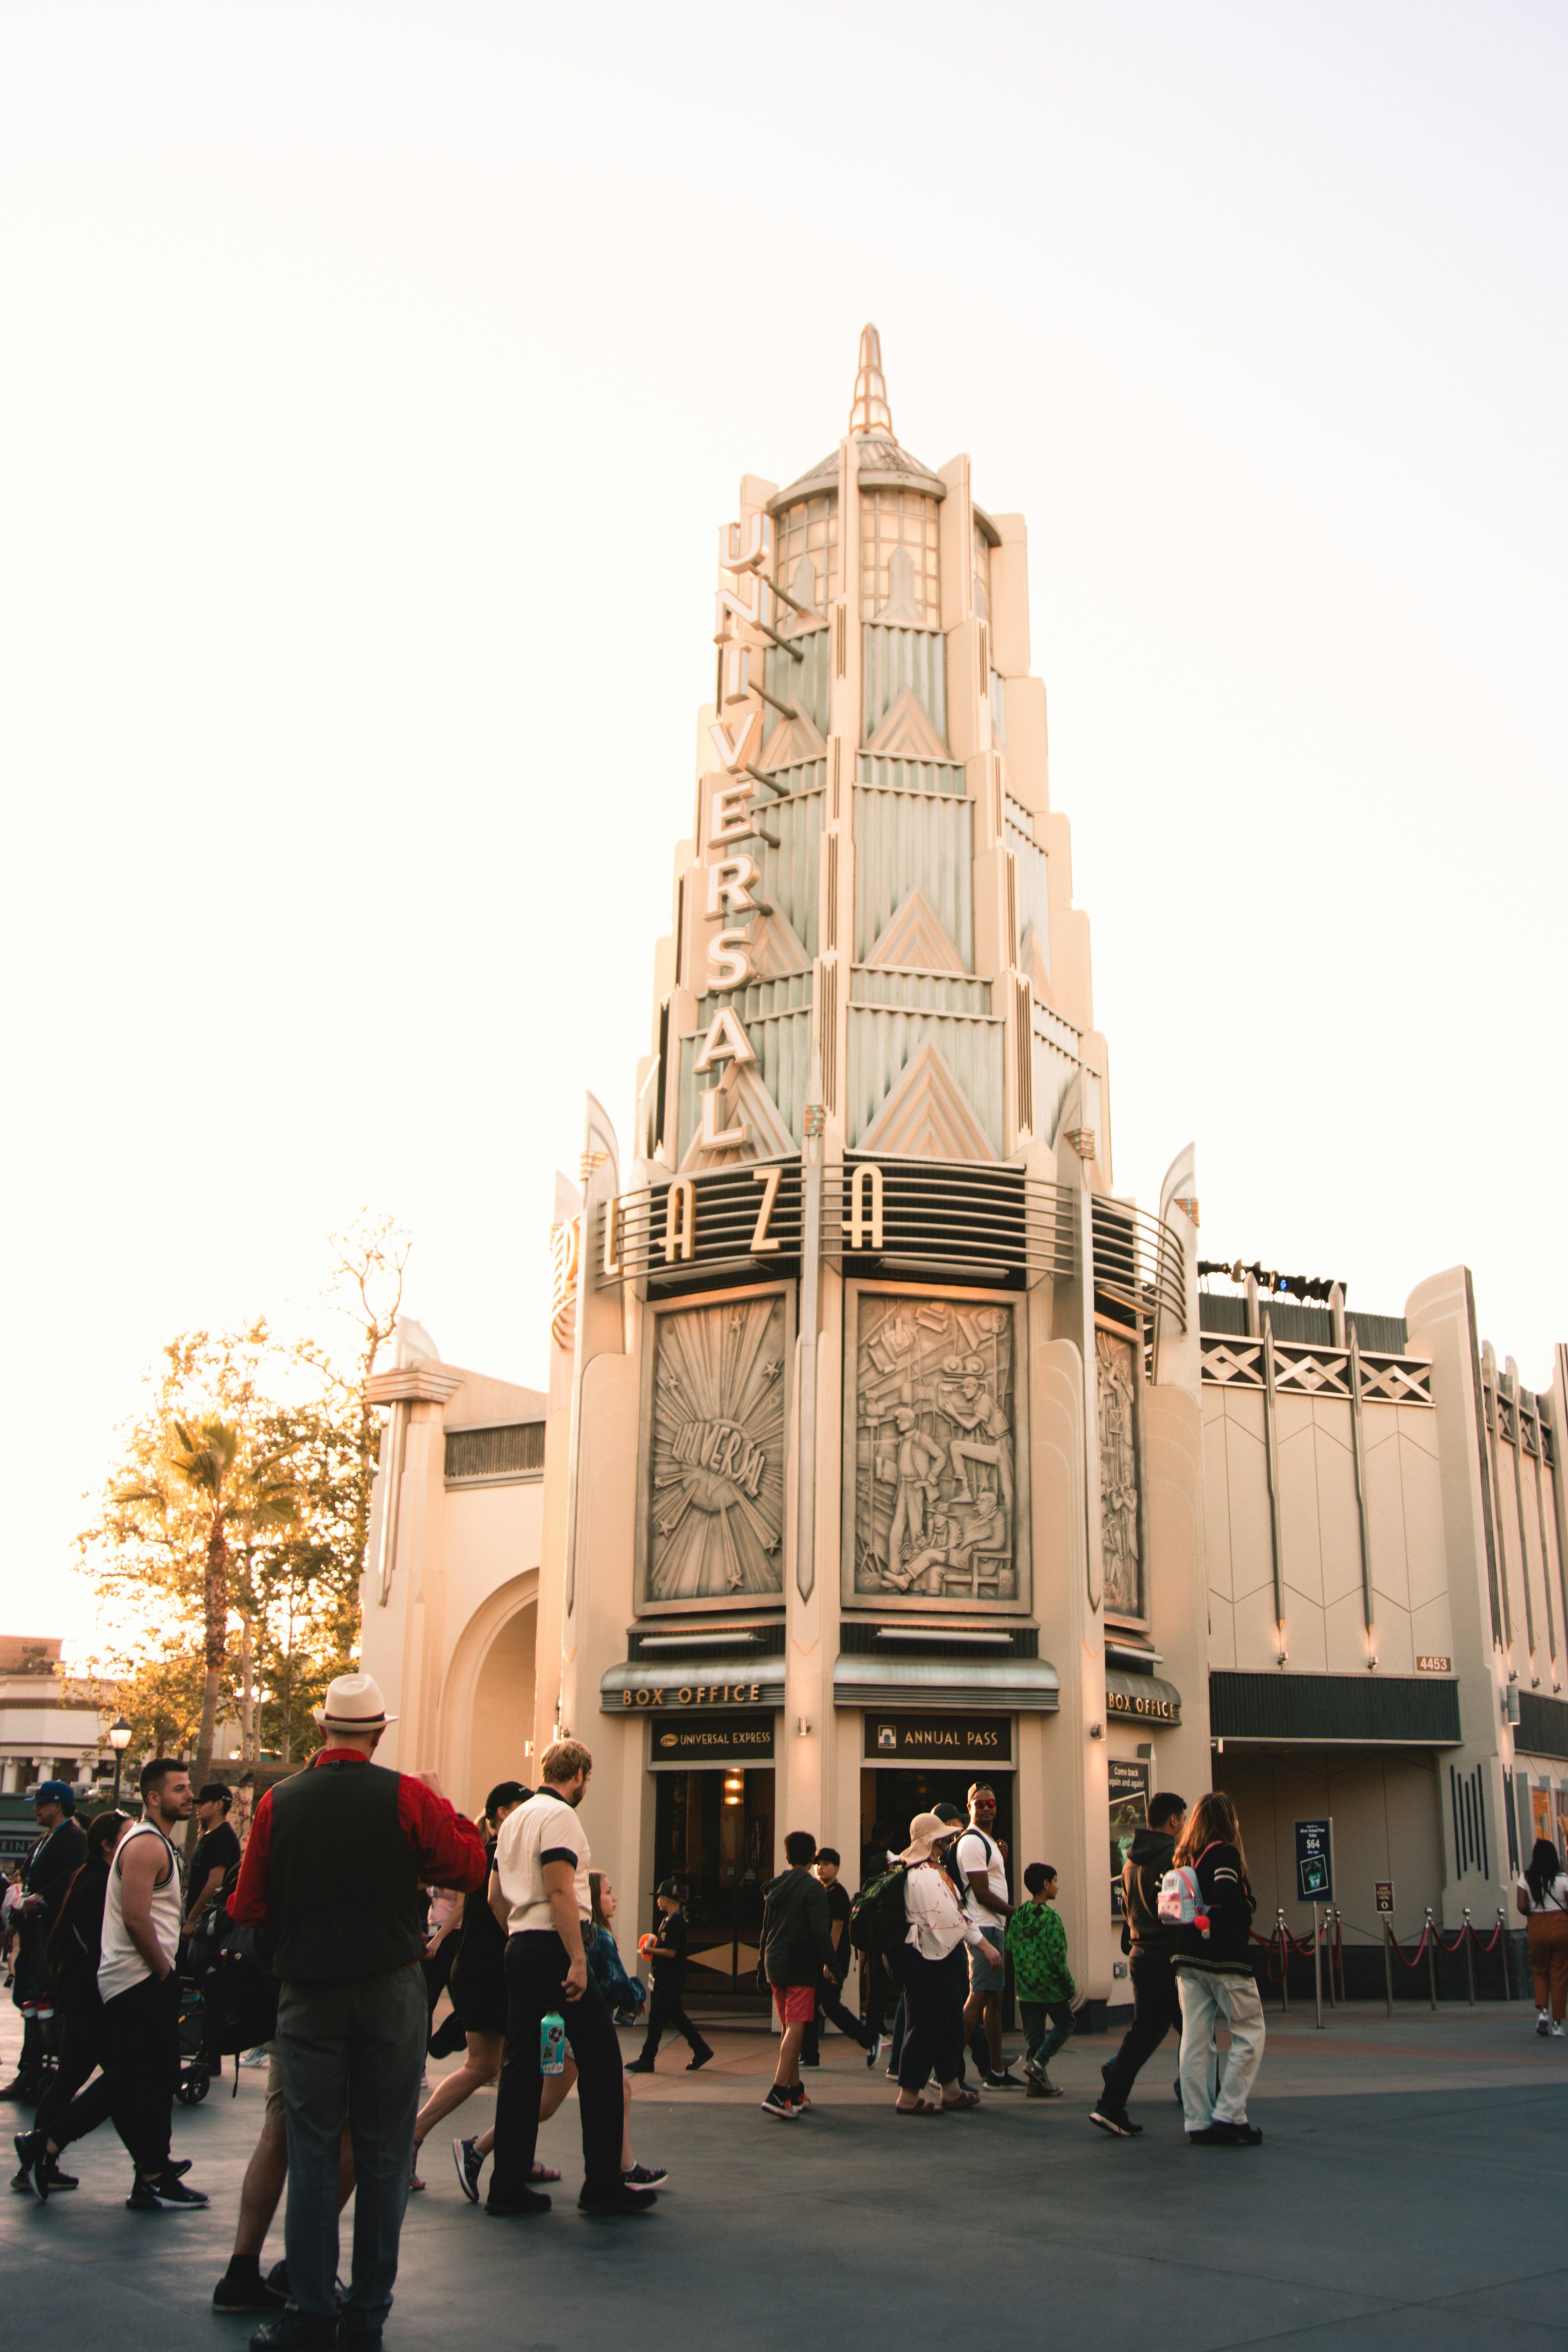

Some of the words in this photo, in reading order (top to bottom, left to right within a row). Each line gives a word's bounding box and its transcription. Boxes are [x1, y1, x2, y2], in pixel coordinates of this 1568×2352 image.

[693, 511, 770, 1152] UNIVERSAL
[672, 1421, 765, 1498] UNIVERSAL
[1420, 1657, 1447, 1670] 4453
[622, 1689, 664, 1706] BOX
[678, 1684, 760, 1704] OFFICE
[1108, 1692, 1130, 1711] BOX
[1136, 1697, 1175, 1718] OFFICE
[680, 1732, 729, 1745] UNIVERSAL
[733, 1731, 771, 1744] EXPRESS
[904, 1730, 960, 1745] ANNUAL
[967, 1731, 998, 1745] PASS
[1114, 1766, 1128, 1776] Come
[1128, 1768, 1139, 1777] back
[1109, 1777, 1121, 1787] again
[1122, 1779, 1130, 1787] and
[1306, 1839, 1320, 1849] $64
